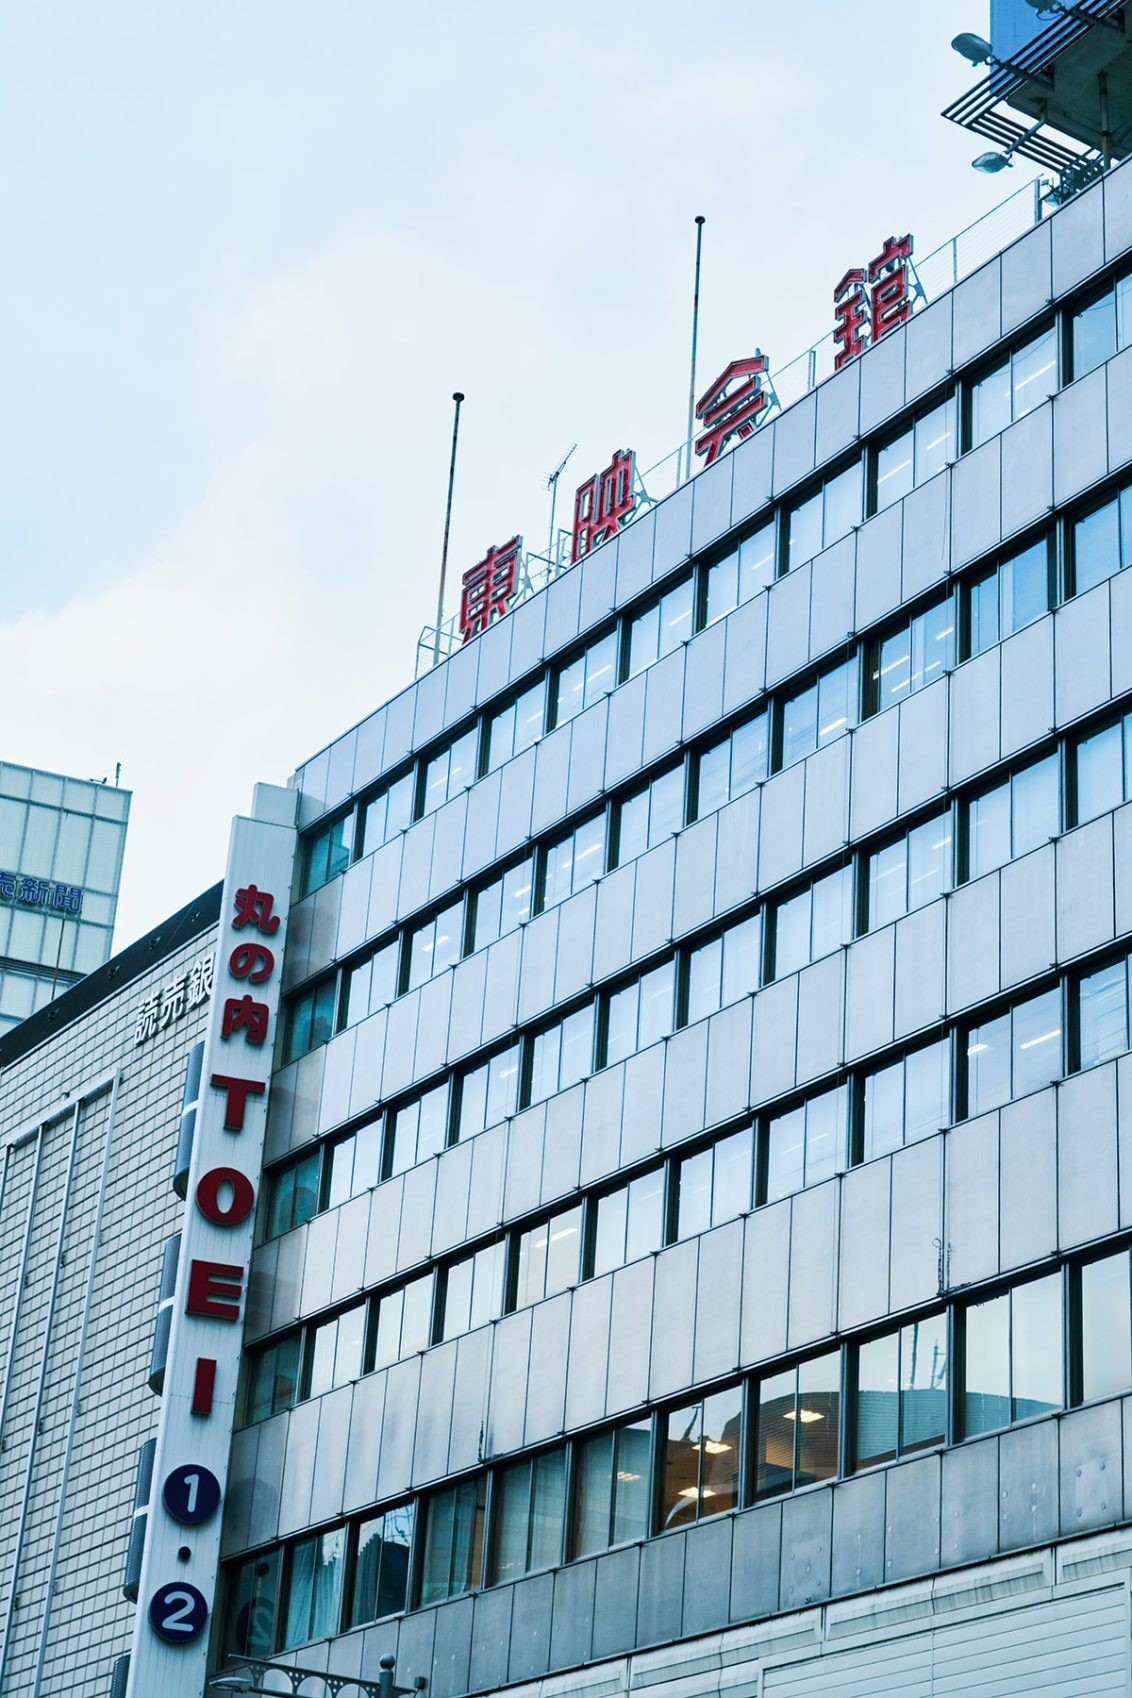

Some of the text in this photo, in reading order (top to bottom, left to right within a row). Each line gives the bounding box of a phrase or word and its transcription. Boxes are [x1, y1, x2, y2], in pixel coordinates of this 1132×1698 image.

[459, 233, 914, 645] 東映会館
[222, 884, 281, 1044] 丸の内
[185, 1073, 267, 1417] TOEI
